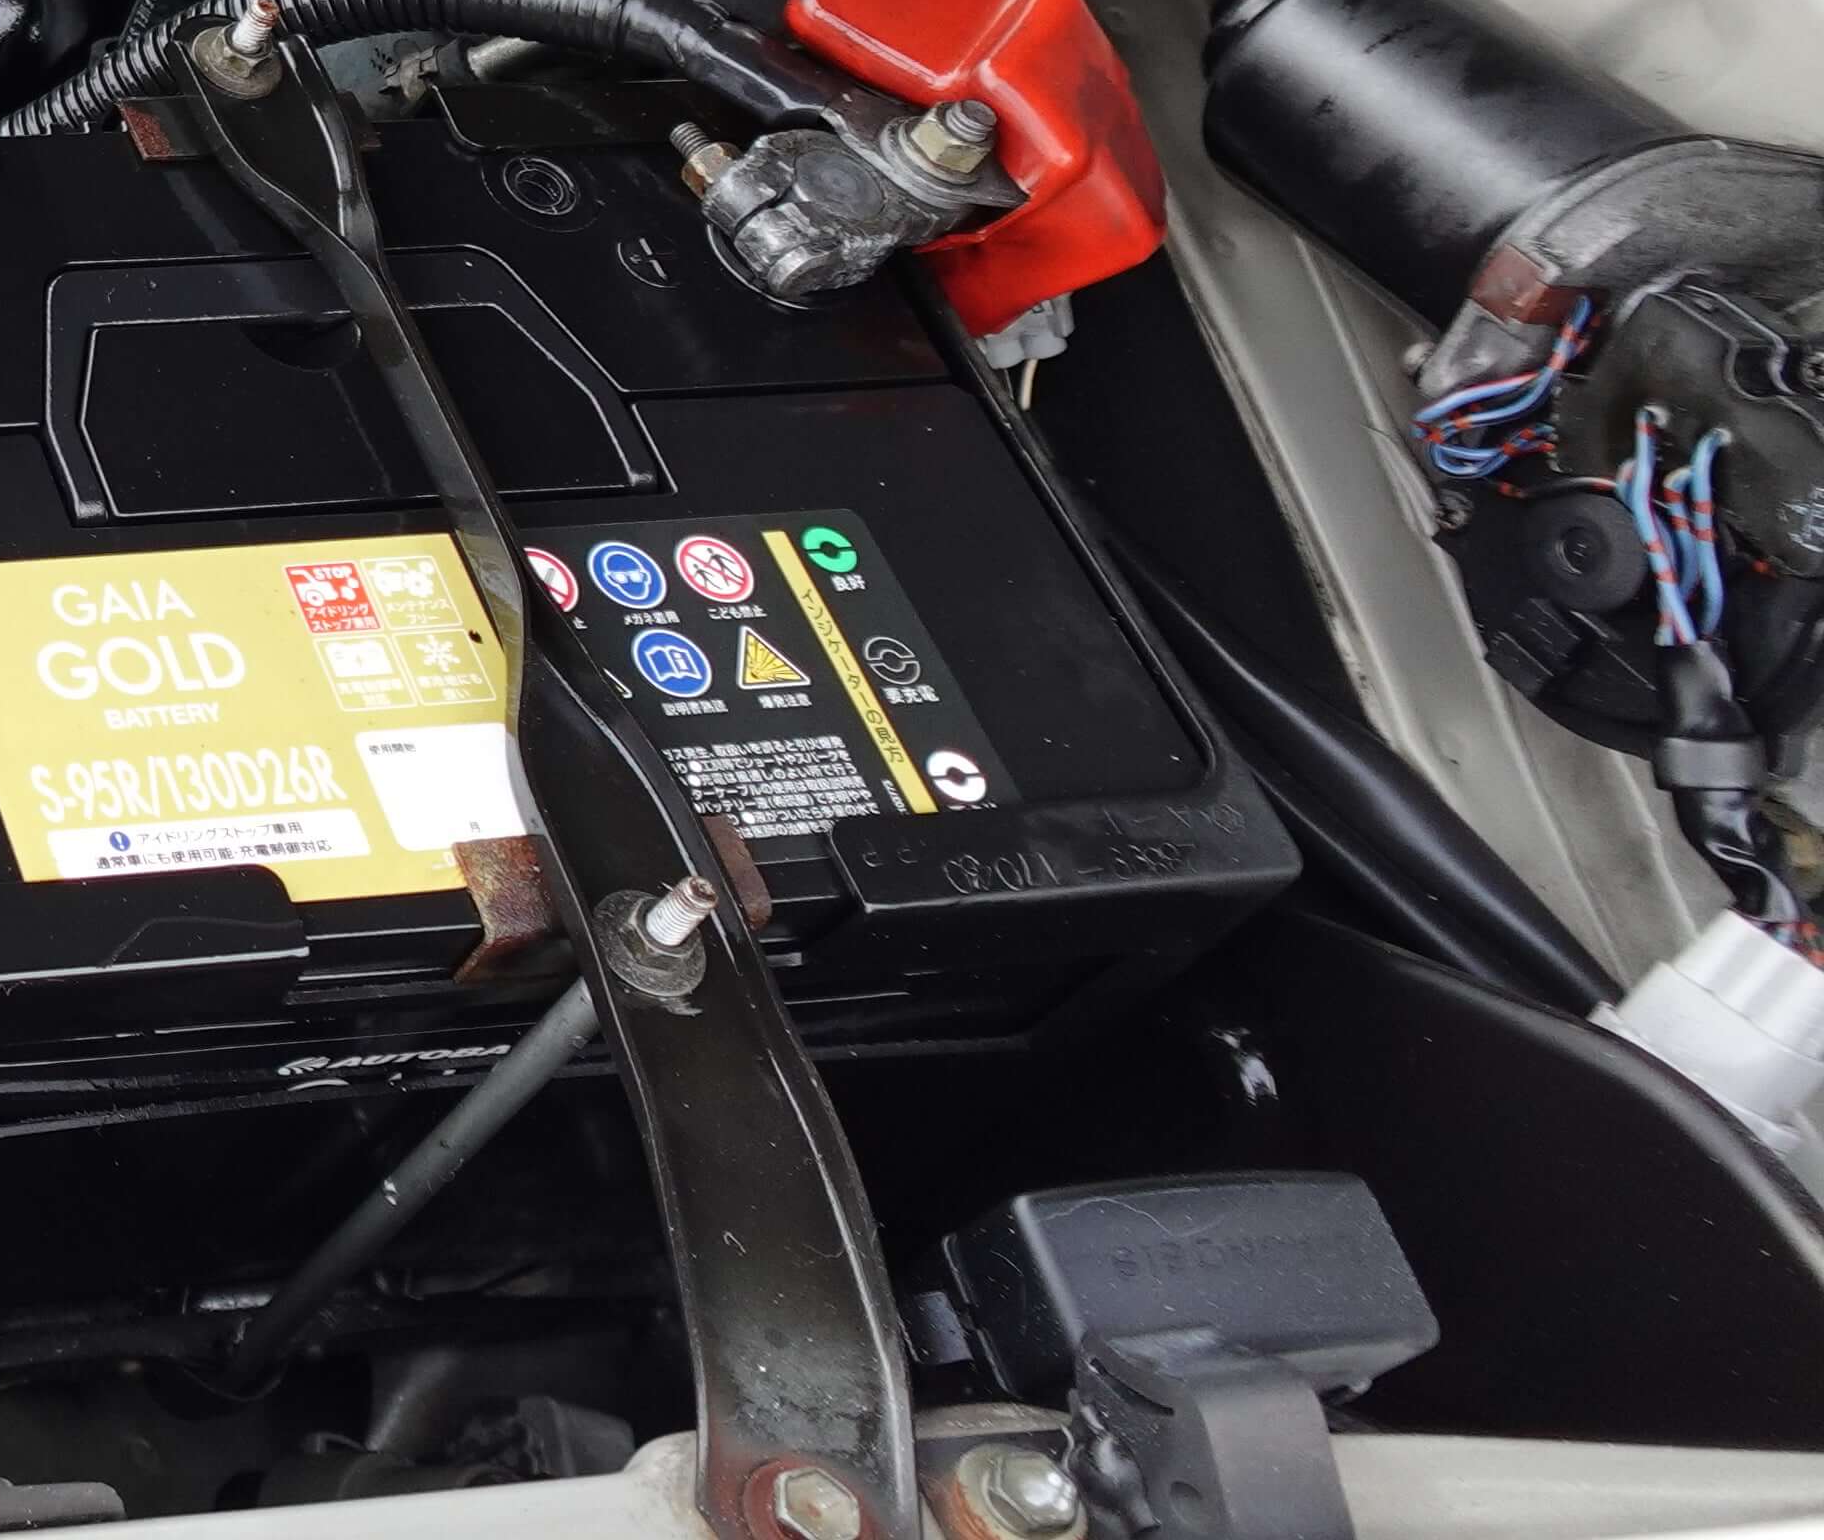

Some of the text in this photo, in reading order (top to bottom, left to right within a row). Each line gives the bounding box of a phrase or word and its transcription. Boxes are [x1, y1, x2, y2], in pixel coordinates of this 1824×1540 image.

[314, 566, 353, 580] STOP
[52, 580, 196, 626] GAIA
[305, 603, 370, 619] アイドリング
[35, 632, 247, 701] GOLD
[103, 701, 221, 730] BATTERY
[31, 745, 348, 823] S-95R/130D26R
[136, 821, 304, 846] アイドリングストップ車用
[328, 1043, 512, 1070] AUTOBA
